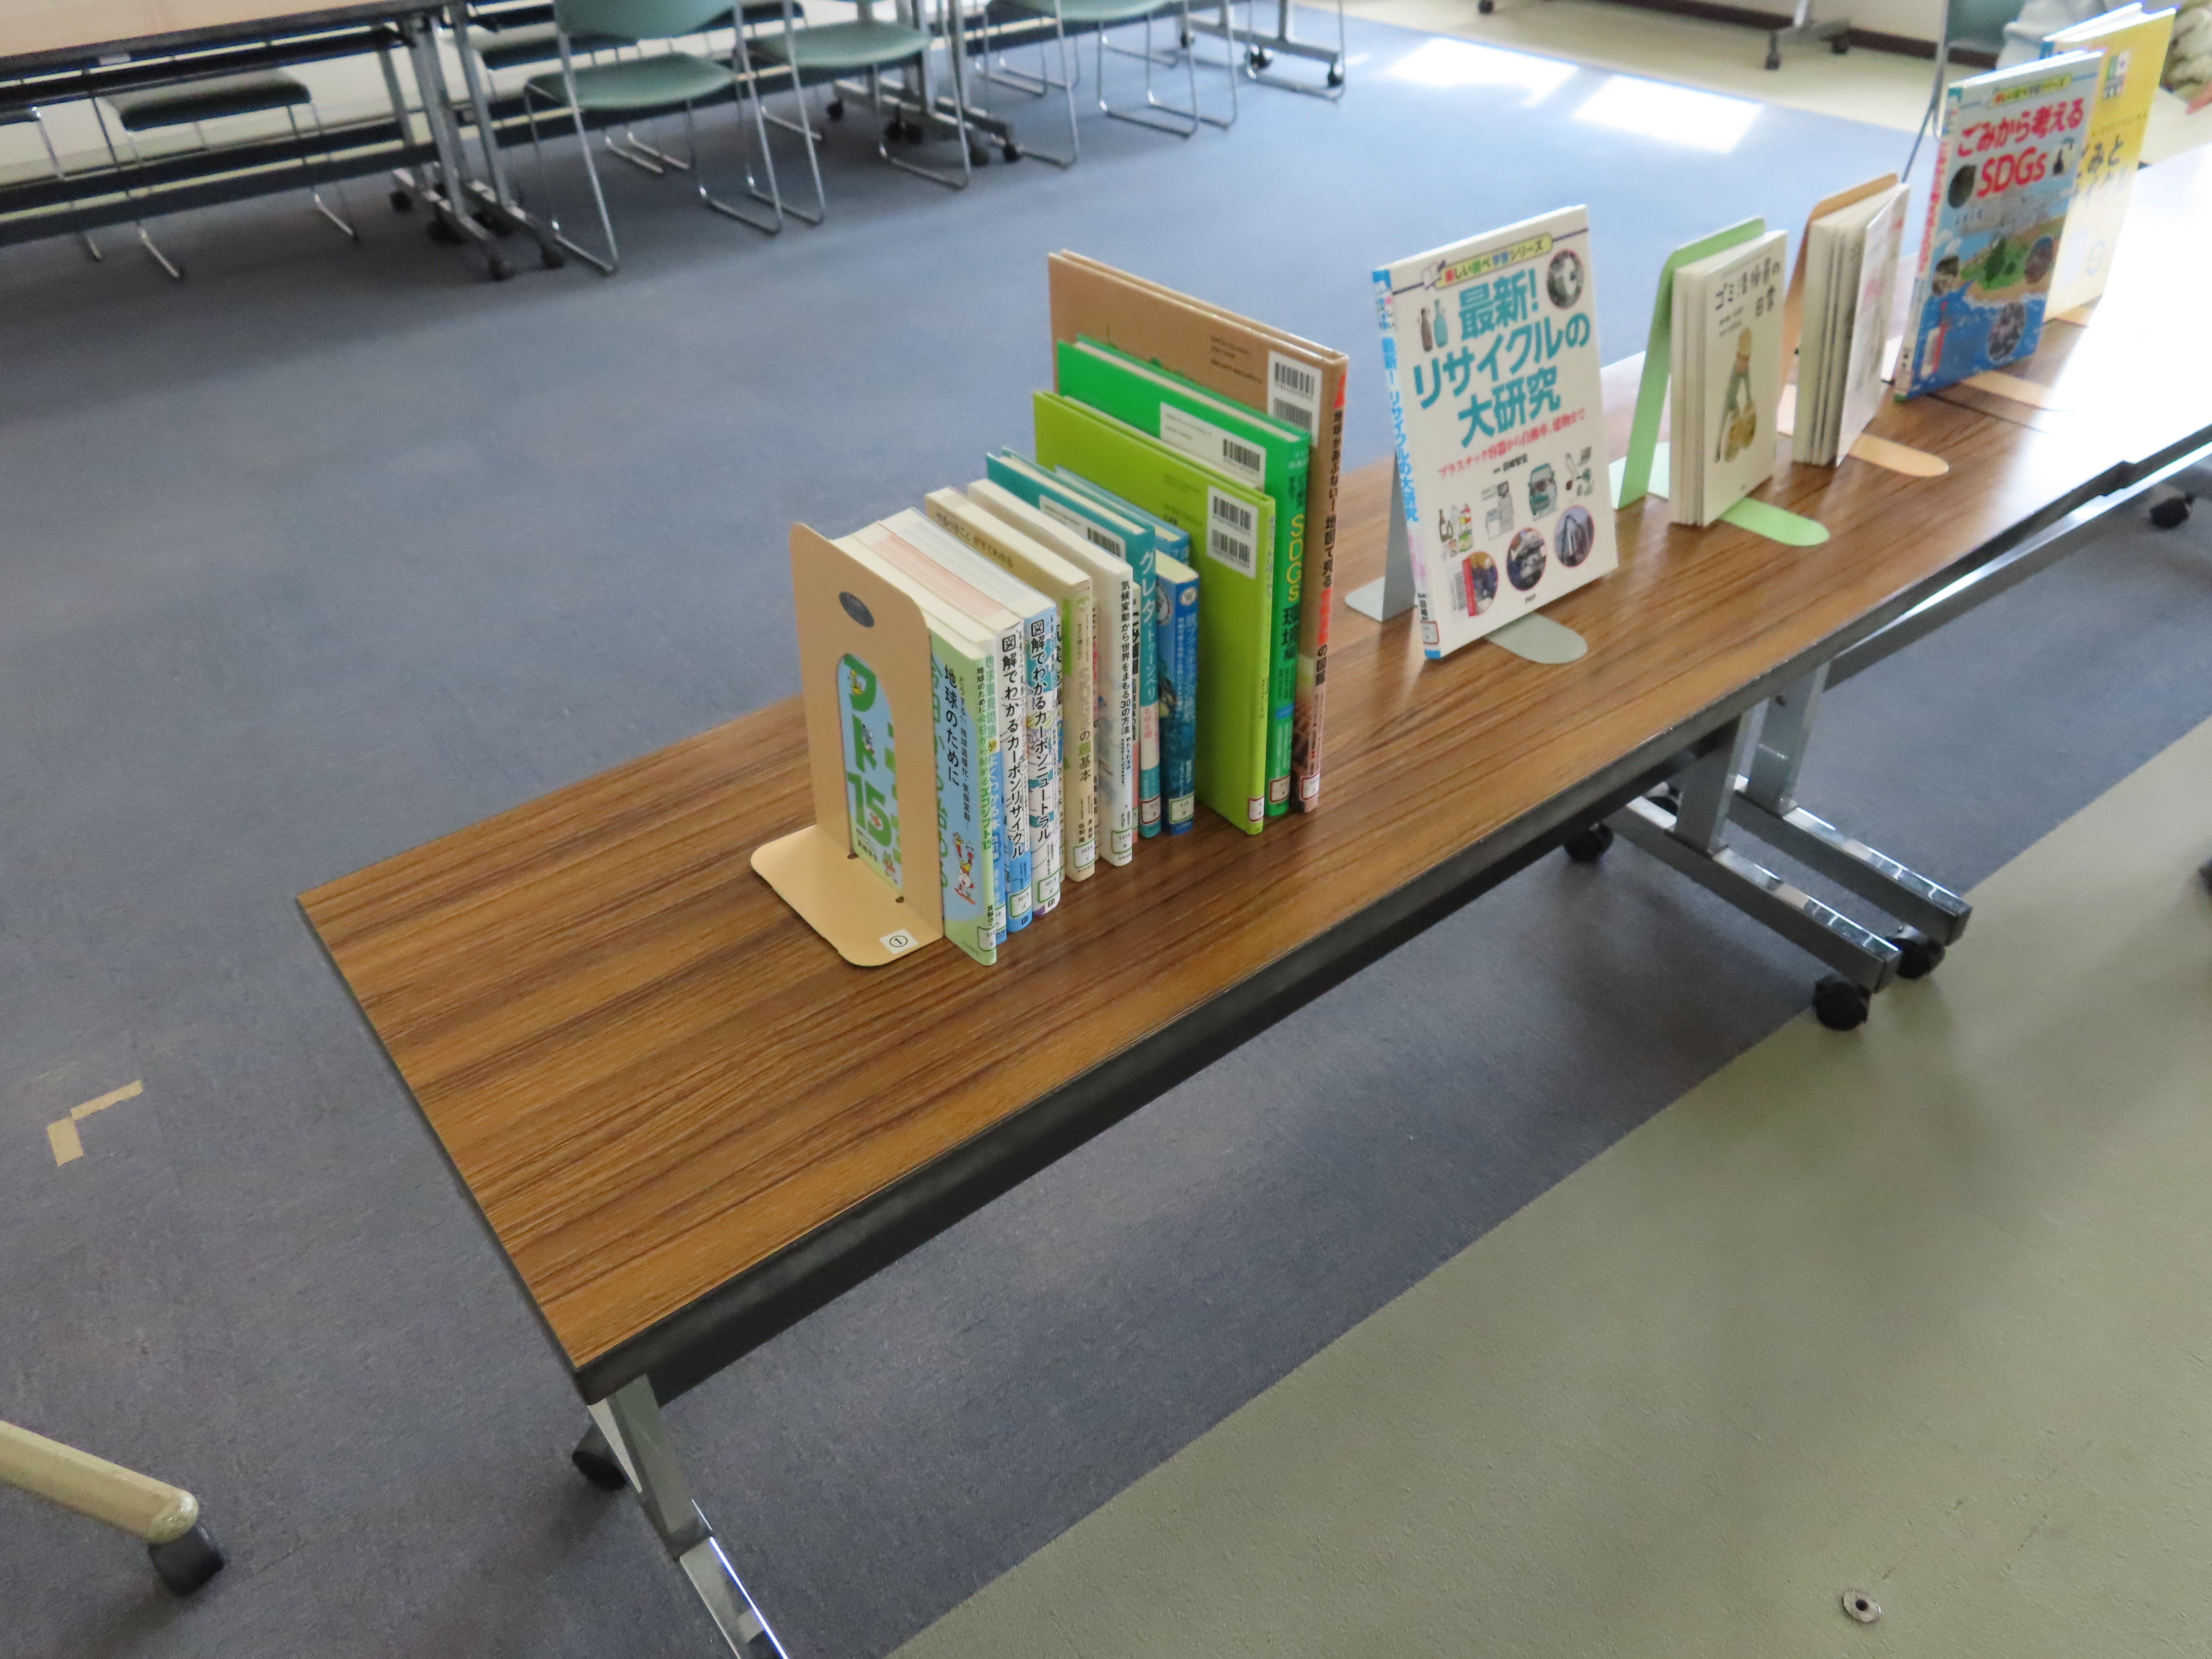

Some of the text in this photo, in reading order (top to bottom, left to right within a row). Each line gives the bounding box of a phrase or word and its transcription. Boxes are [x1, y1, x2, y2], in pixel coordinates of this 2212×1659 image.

[1957, 97, 2084, 157] ごみから考える
[1977, 146, 2047, 198] SDGs
[1445, 239, 1543, 282] 楽しい調べ学習シリーズ
[1459, 269, 1538, 341] 最新!
[1413, 312, 1591, 410] リサイクルの
[1458, 366, 1561, 448] 大研究
[1286, 514, 1305, 602] SDGs
[1120, 580, 1131, 735] 気候変動から世界をまもる30の方法
[1140, 551, 1156, 700] グレタ・トゥーンベリ
[944, 664, 960, 786] 地球のために
[1002, 634, 1025, 859] 図解でわかるカーボンリサイクル
[1031, 619, 1051, 844] 図解でわかるカーボンニュートラル
